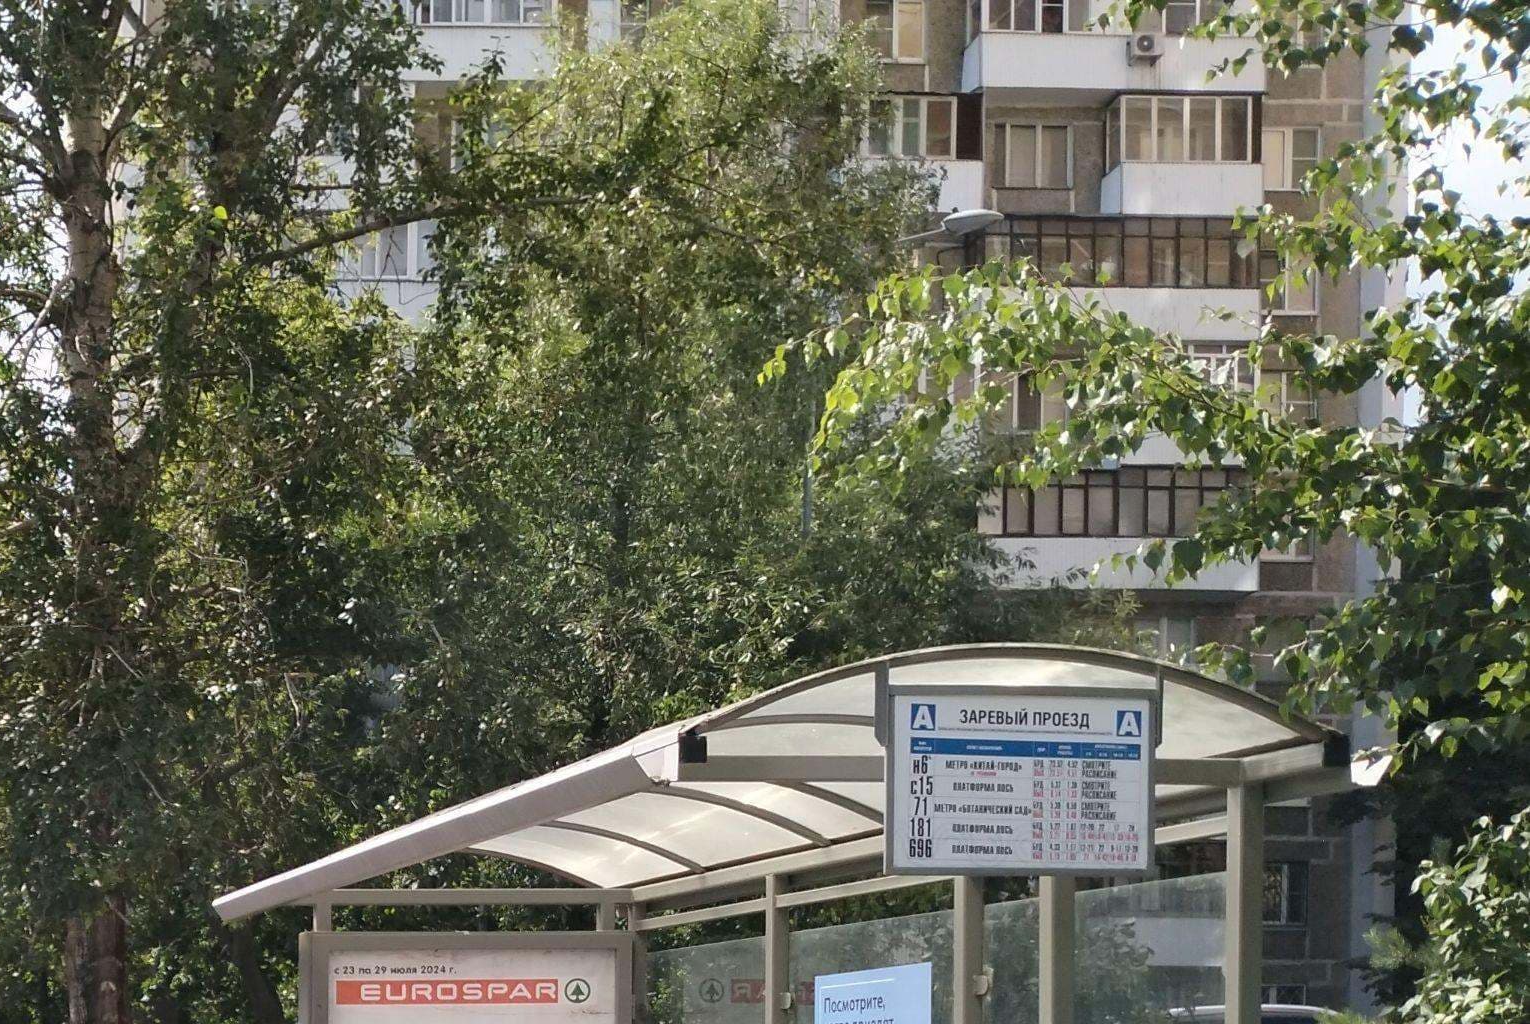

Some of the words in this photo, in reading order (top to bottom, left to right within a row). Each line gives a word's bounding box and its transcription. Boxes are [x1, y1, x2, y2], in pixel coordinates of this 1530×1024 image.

[959, 707, 1028, 726] ЗАРЕВЫЙ
[1032, 711, 1090, 730] ПРОЕЗД
[945, 760, 968, 770] МЕТРО
[914, 797, 928, 816] 71
[934, 803, 957, 813] МЕТРО
[910, 818, 931, 837] 181
[909, 839, 932, 858] 696
[342, 966, 355, 975] 23
[375, 966, 387, 974] 29
[421, 965, 446, 974] 2024
[360, 983, 557, 1001] EUROSPAR
[824, 996, 886, 1014] Посмотрите,
